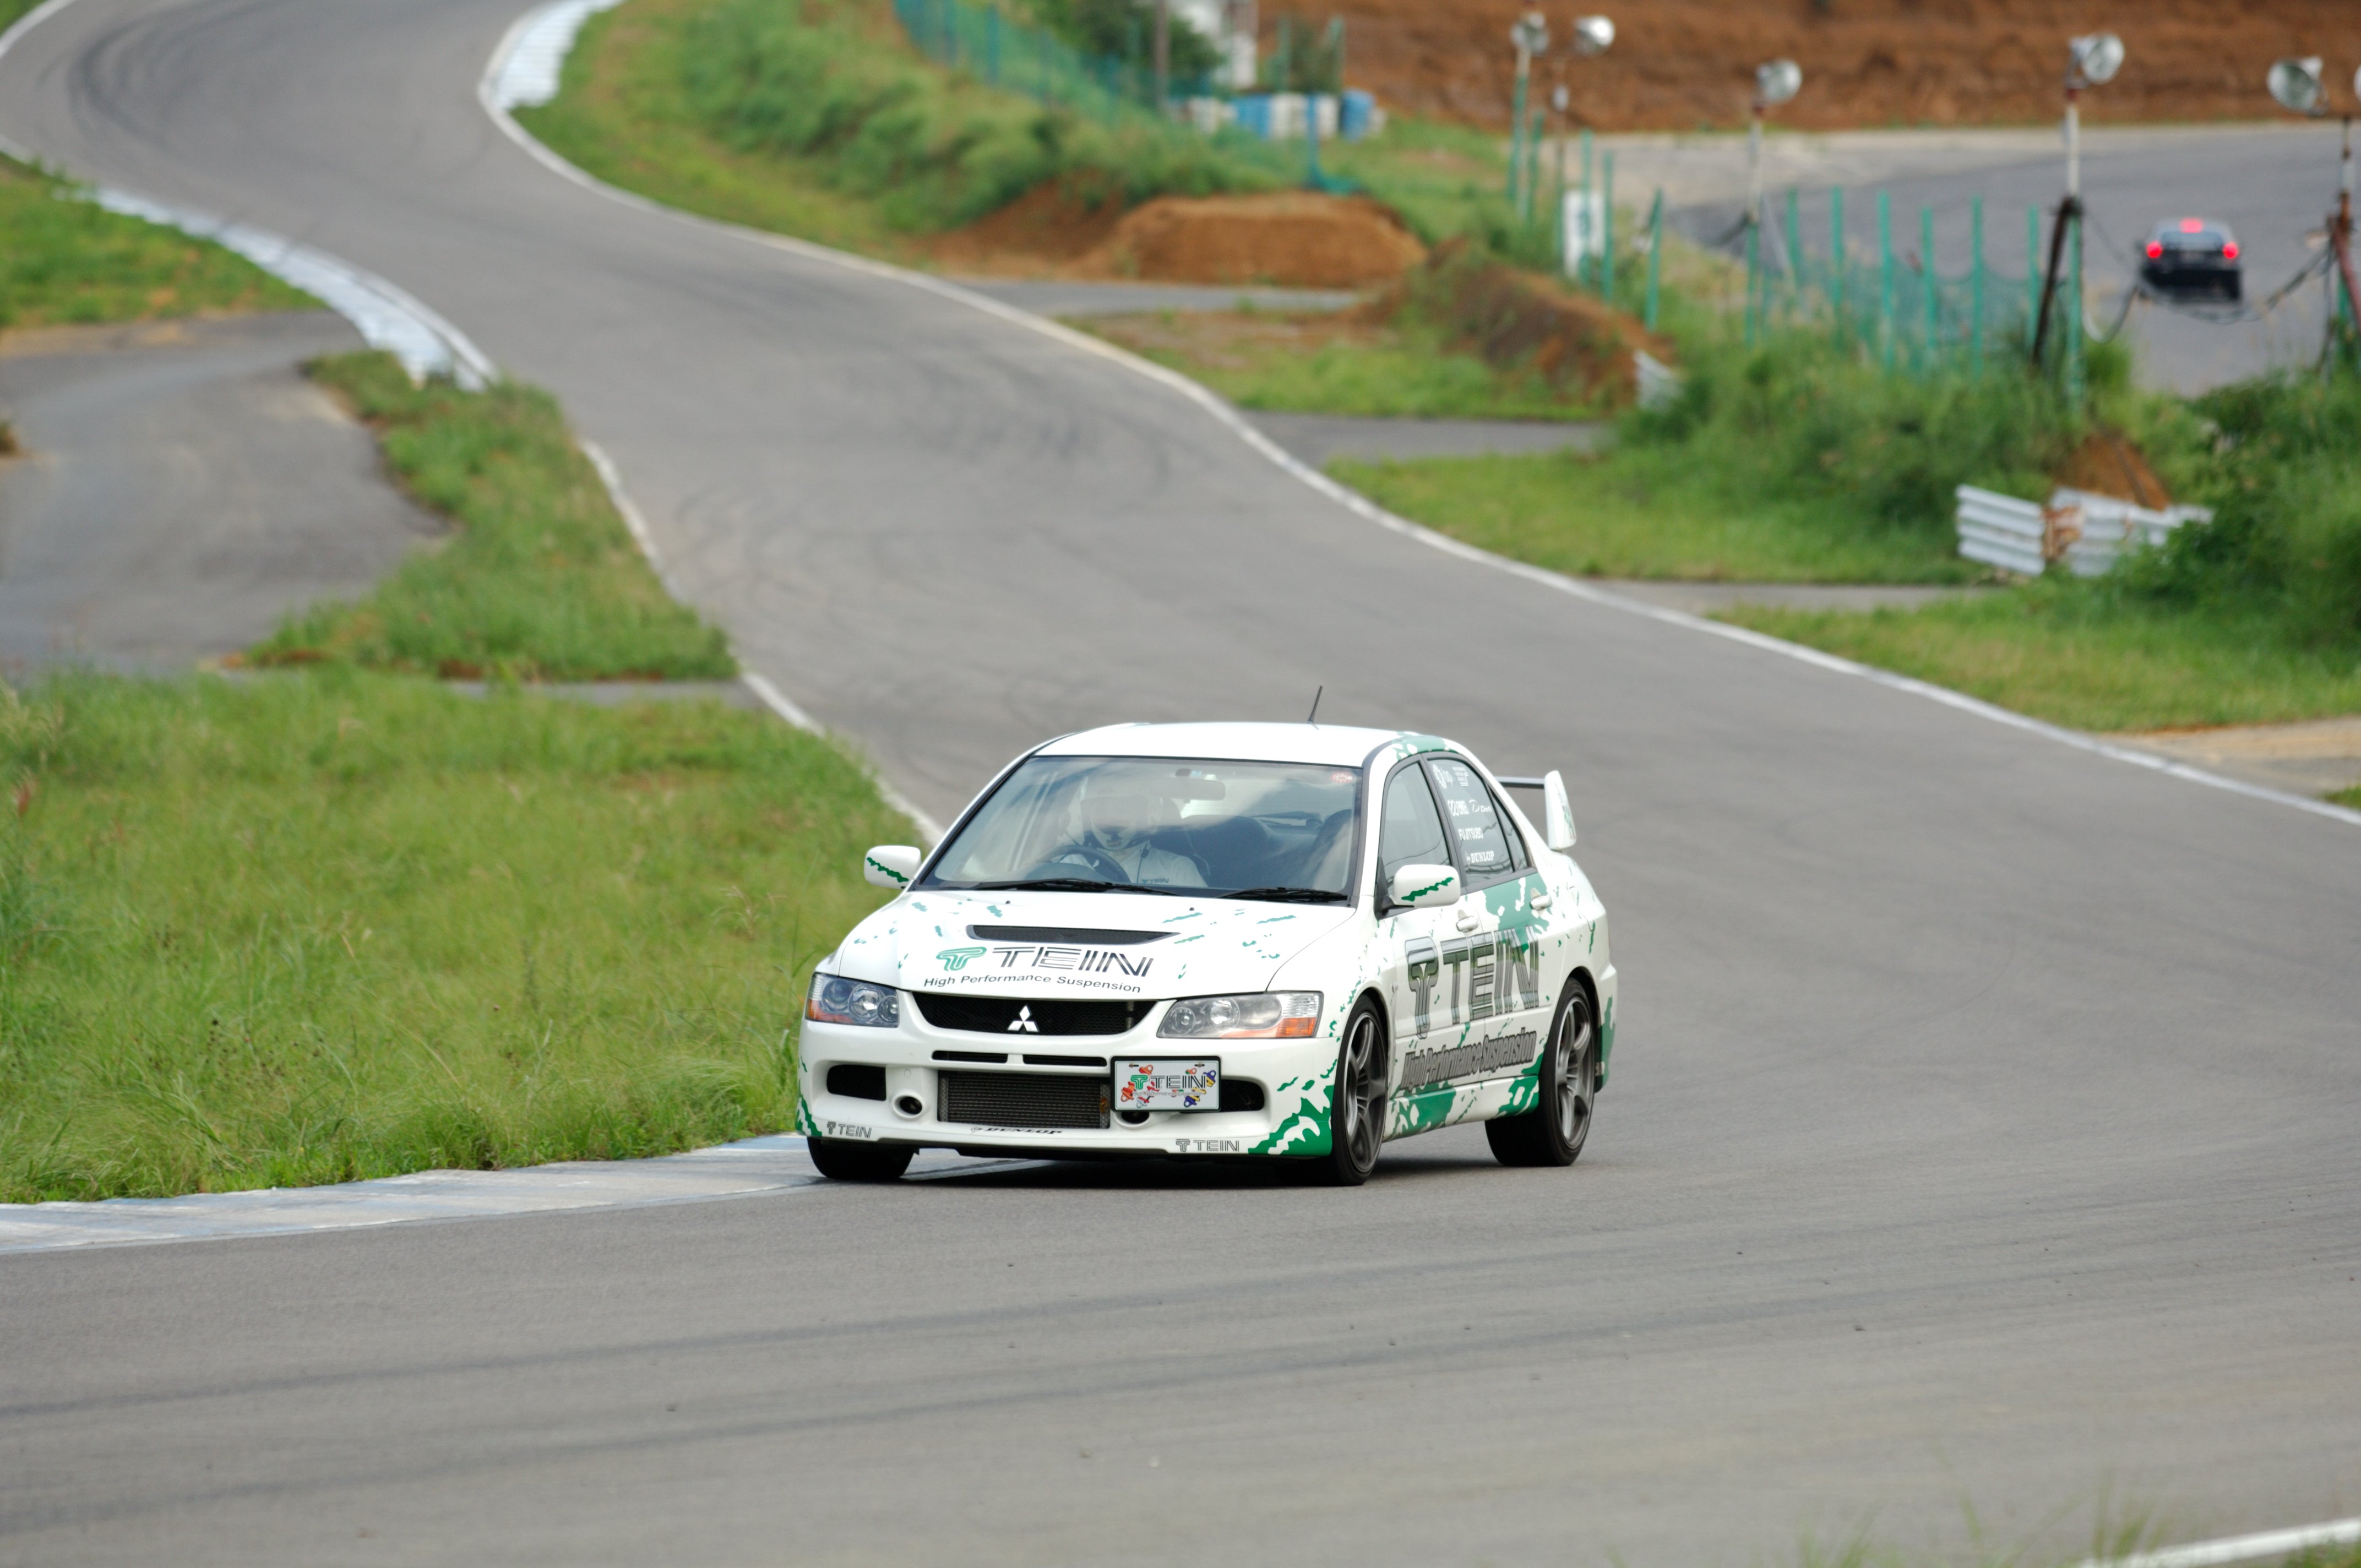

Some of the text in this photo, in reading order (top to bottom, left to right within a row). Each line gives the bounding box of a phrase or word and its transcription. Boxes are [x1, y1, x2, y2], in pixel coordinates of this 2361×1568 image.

[1458, 827, 1483, 841] FUJITSUBO
[1470, 851, 1494, 863] DUNLOP
[992, 946, 1155, 978] TEIN
[1440, 924, 1539, 1025] TEIN
[924, 973, 1141, 993] High Performance Suspension
[1401, 1027, 1536, 1092] High Performance Suspension
[1150, 1075, 1206, 1088] TEIN
[838, 1124, 872, 1139] TEIN
[1193, 1140, 1239, 1152] TEIN
